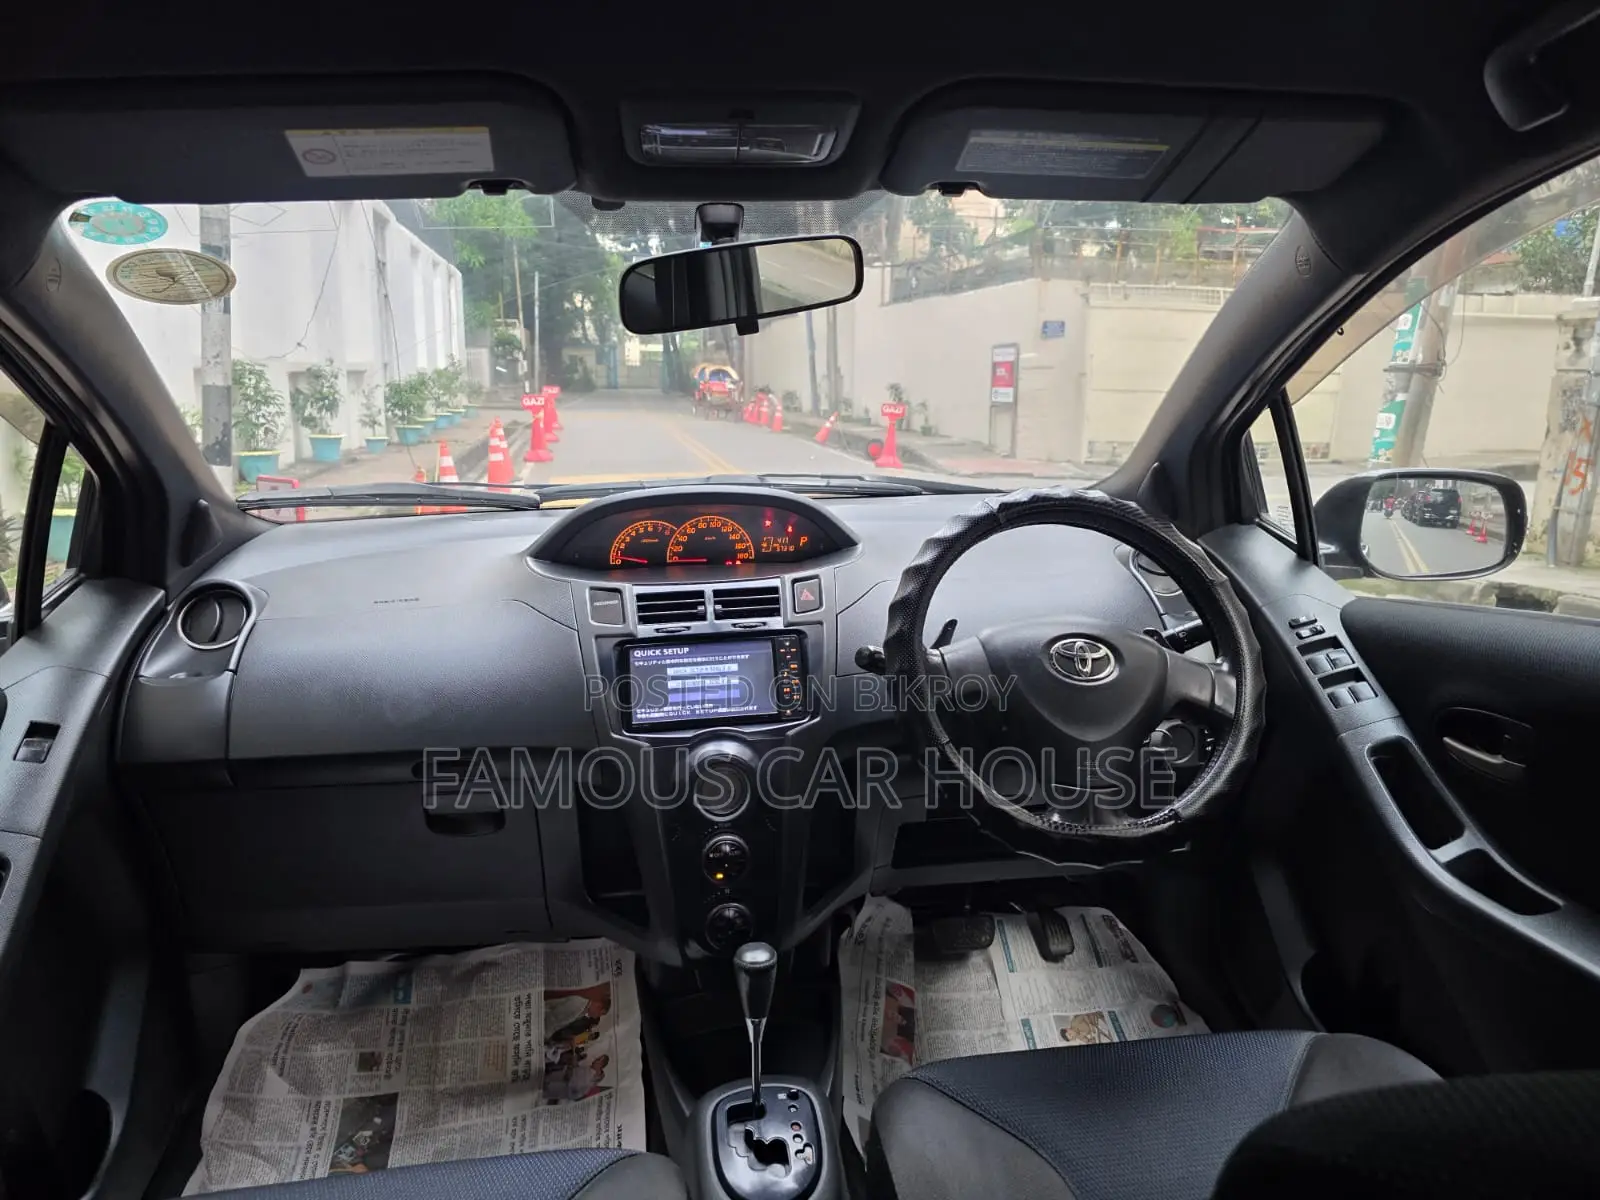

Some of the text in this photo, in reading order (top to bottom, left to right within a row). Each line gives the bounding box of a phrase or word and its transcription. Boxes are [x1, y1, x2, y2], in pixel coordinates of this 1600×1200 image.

[800, 536, 808, 546] P
[633, 647, 690, 658] QUICK SETUP
